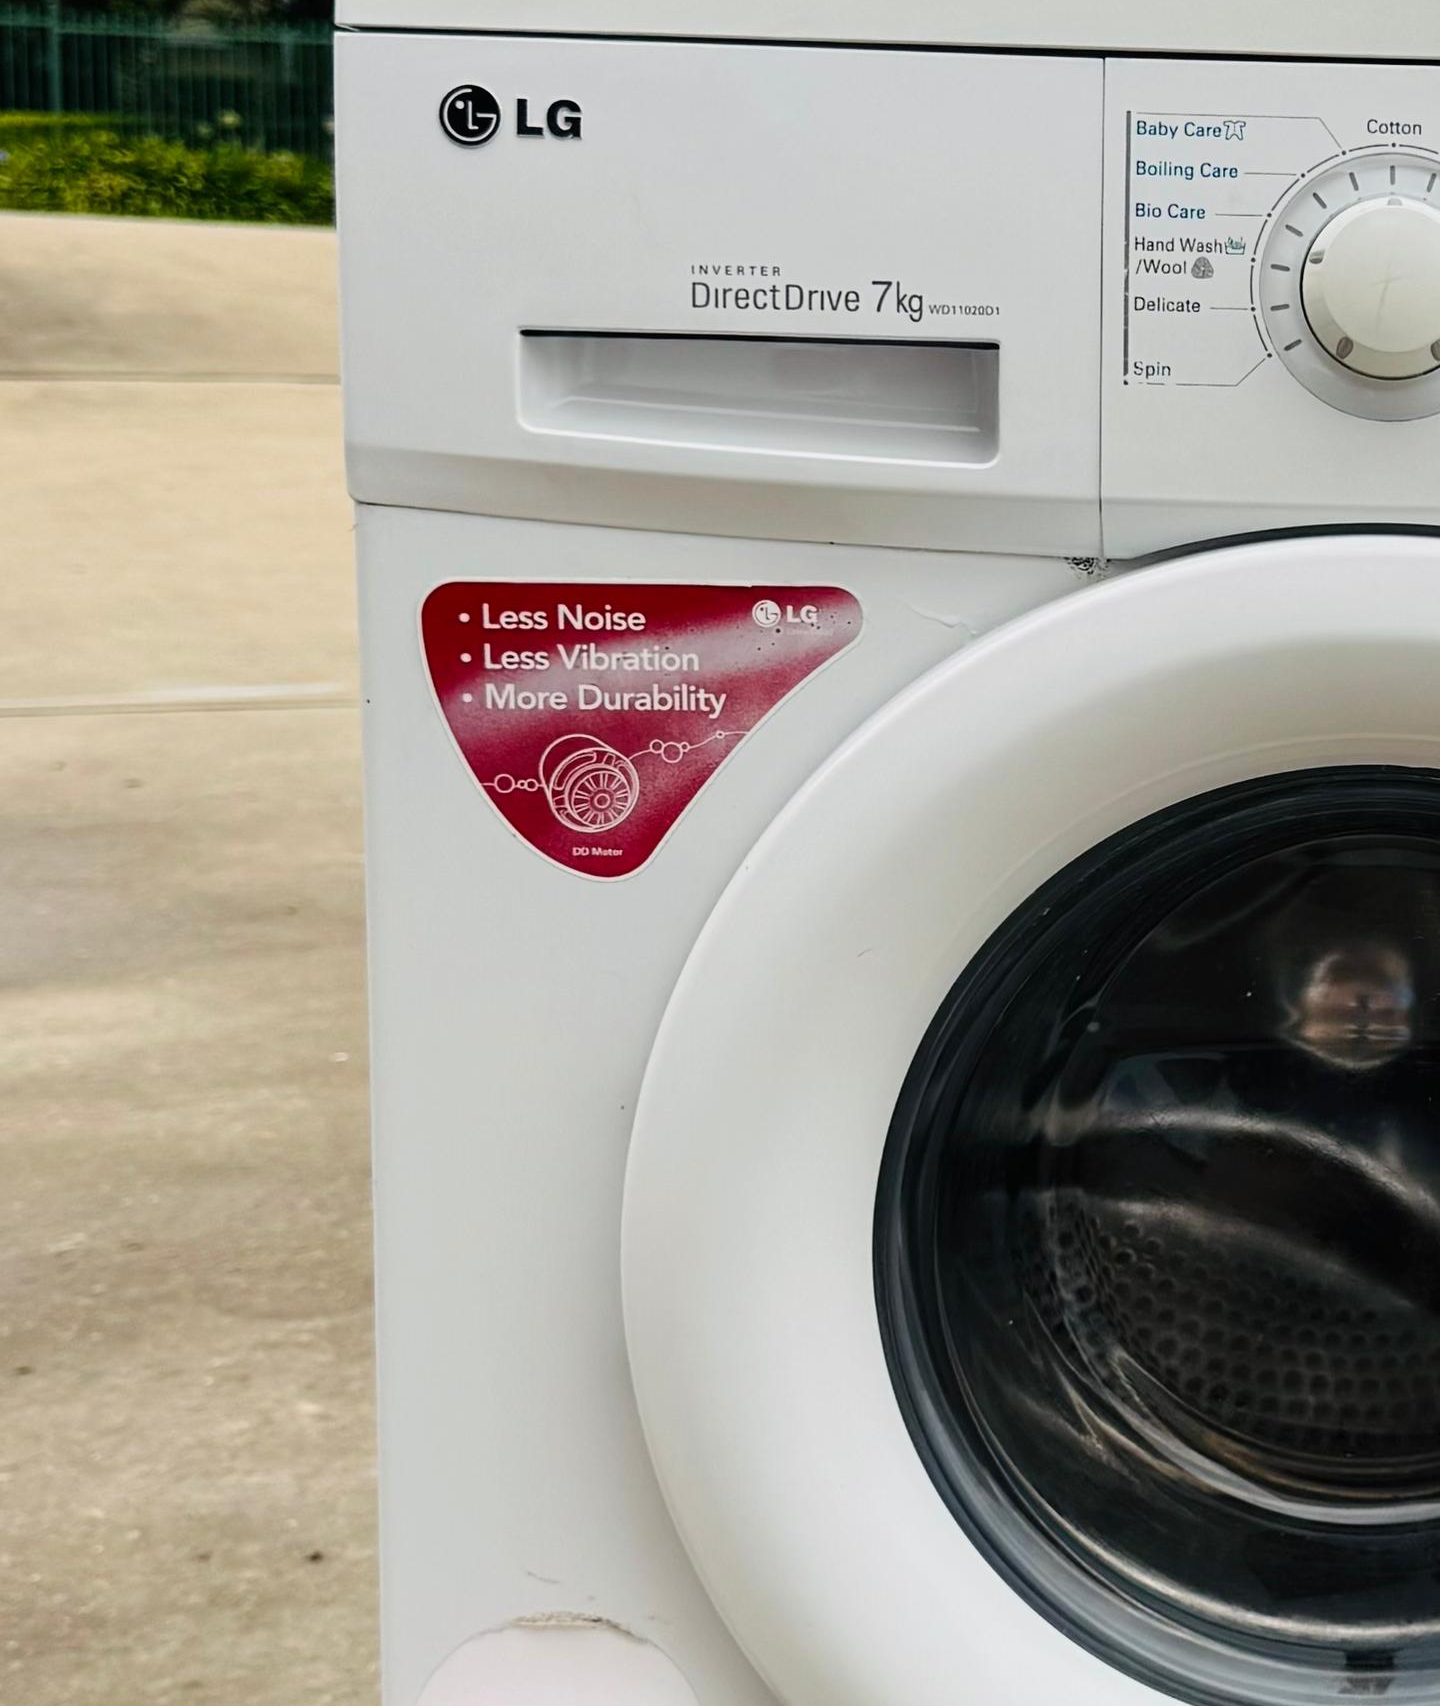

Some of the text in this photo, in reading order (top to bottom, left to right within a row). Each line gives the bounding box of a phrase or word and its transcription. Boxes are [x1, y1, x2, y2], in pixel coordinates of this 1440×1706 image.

[516, 99, 582, 140] LG
[1366, 119, 1422, 137] Cotton
[1136, 121, 1222, 140] Baby Care
[1136, 162, 1238, 180] Boiling Care
[1135, 203, 1206, 219] Bio Care
[1134, 236, 1223, 254] Hand Wash
[690, 264, 781, 277] INVERTER
[1136, 259, 1187, 276] /Wool
[1134, 296, 1201, 314] Delicate
[1134, 361, 1172, 378] Spin
[482, 604, 646, 631] Less Noise
[786, 604, 818, 624] LG
[484, 643, 700, 672] Less Vibration
[484, 683, 727, 719] More Durability
